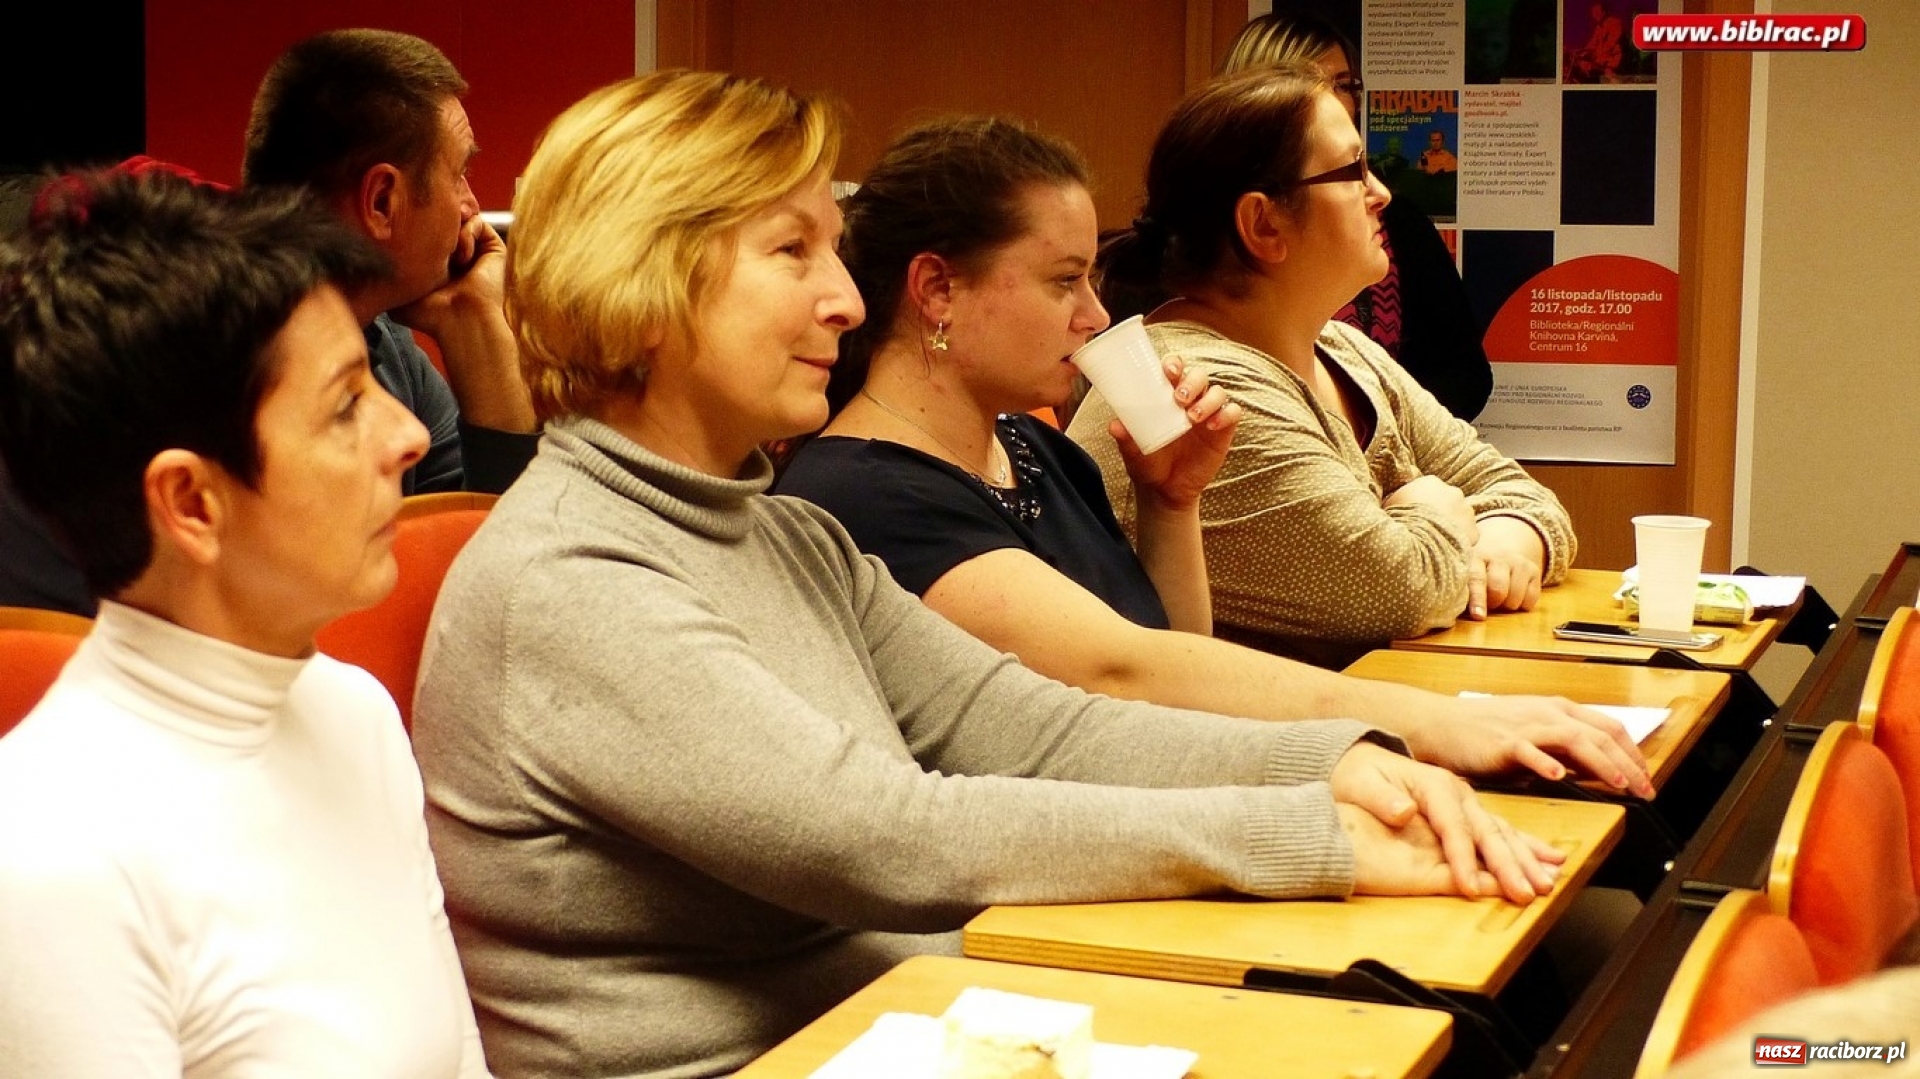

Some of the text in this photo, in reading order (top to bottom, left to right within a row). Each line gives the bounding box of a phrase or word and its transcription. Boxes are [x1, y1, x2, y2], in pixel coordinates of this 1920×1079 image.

[1370, 90, 1460, 113] HRABAL
[1369, 115, 1432, 124] pod specjalnym
[1531, 288, 1663, 303] 16 listopada/listopadu
[1530, 302, 1633, 316] 2017, godz. 17.00
[1530, 320, 1634, 332] Biblioteka/Regionální
[1529, 331, 1618, 342] Knihovna Karviná,
[1529, 341, 1588, 352] Centrum 16
